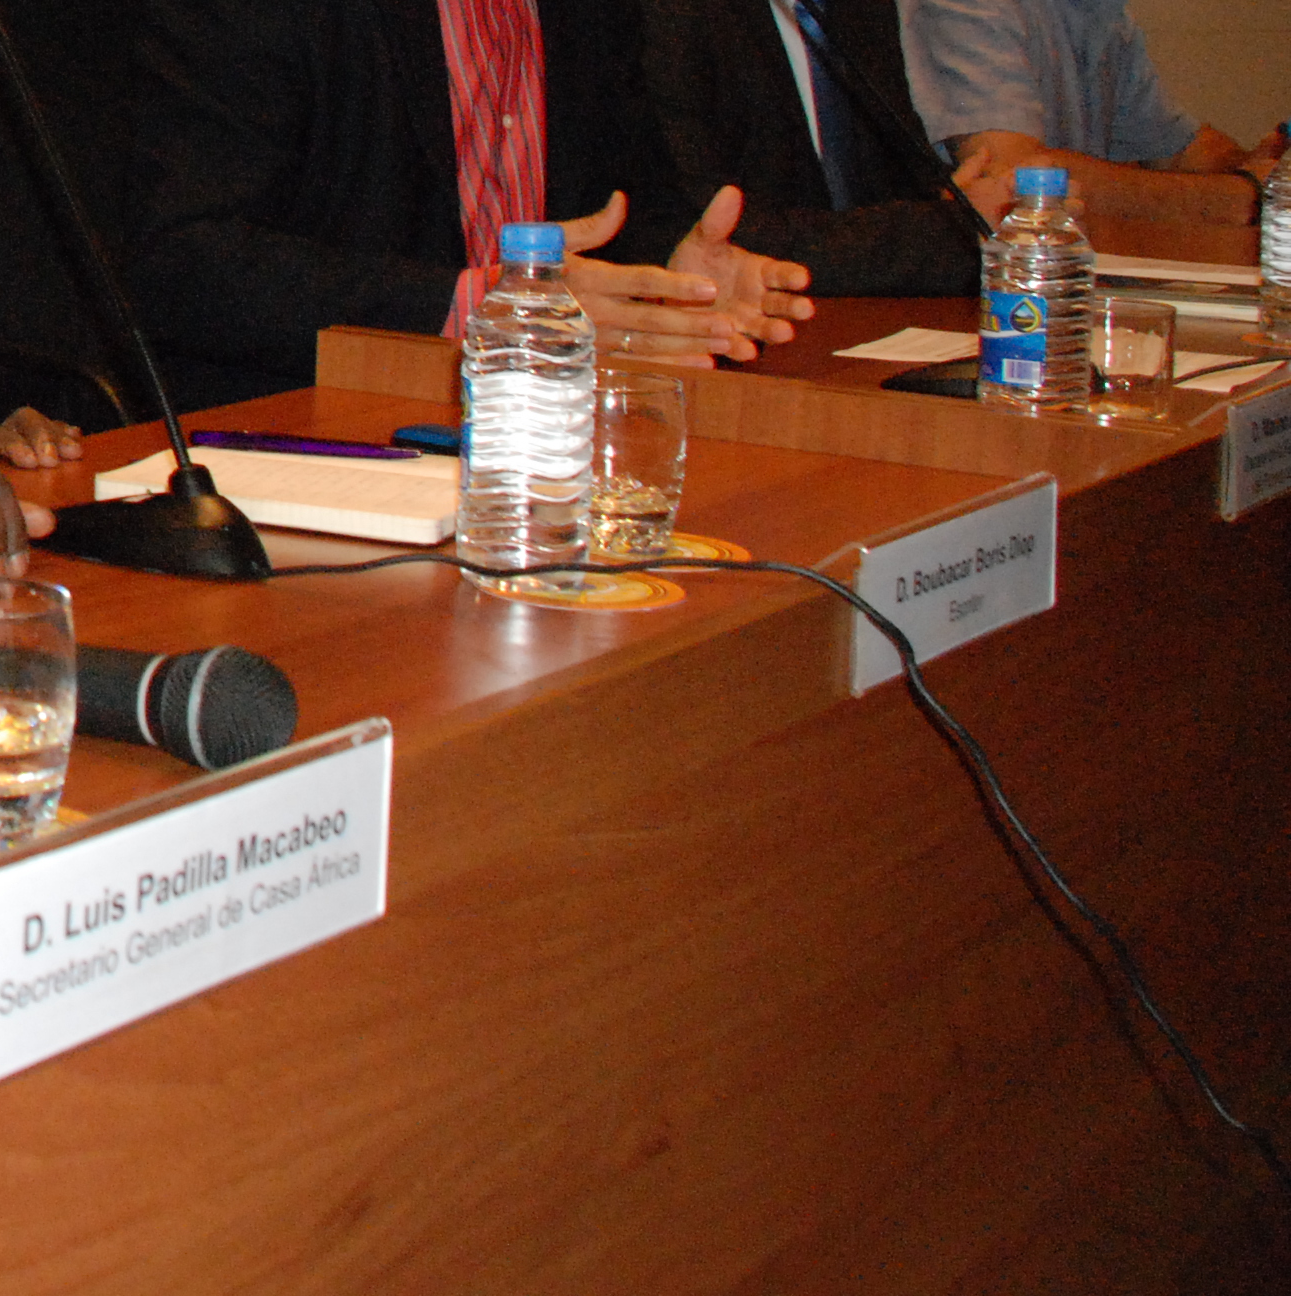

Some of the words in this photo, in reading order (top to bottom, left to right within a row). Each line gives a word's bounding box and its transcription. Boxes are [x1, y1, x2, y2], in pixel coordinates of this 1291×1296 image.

[23, 912, 53, 955] D.
[64, 890, 125, 937] Luis
[136, 851, 227, 912] Padilla
[236, 808, 347, 870] Macabeo
[125, 905, 211, 965] General
[217, 896, 243, 929] de
[249, 872, 300, 915] Casa
[307, 850, 360, 890] África
